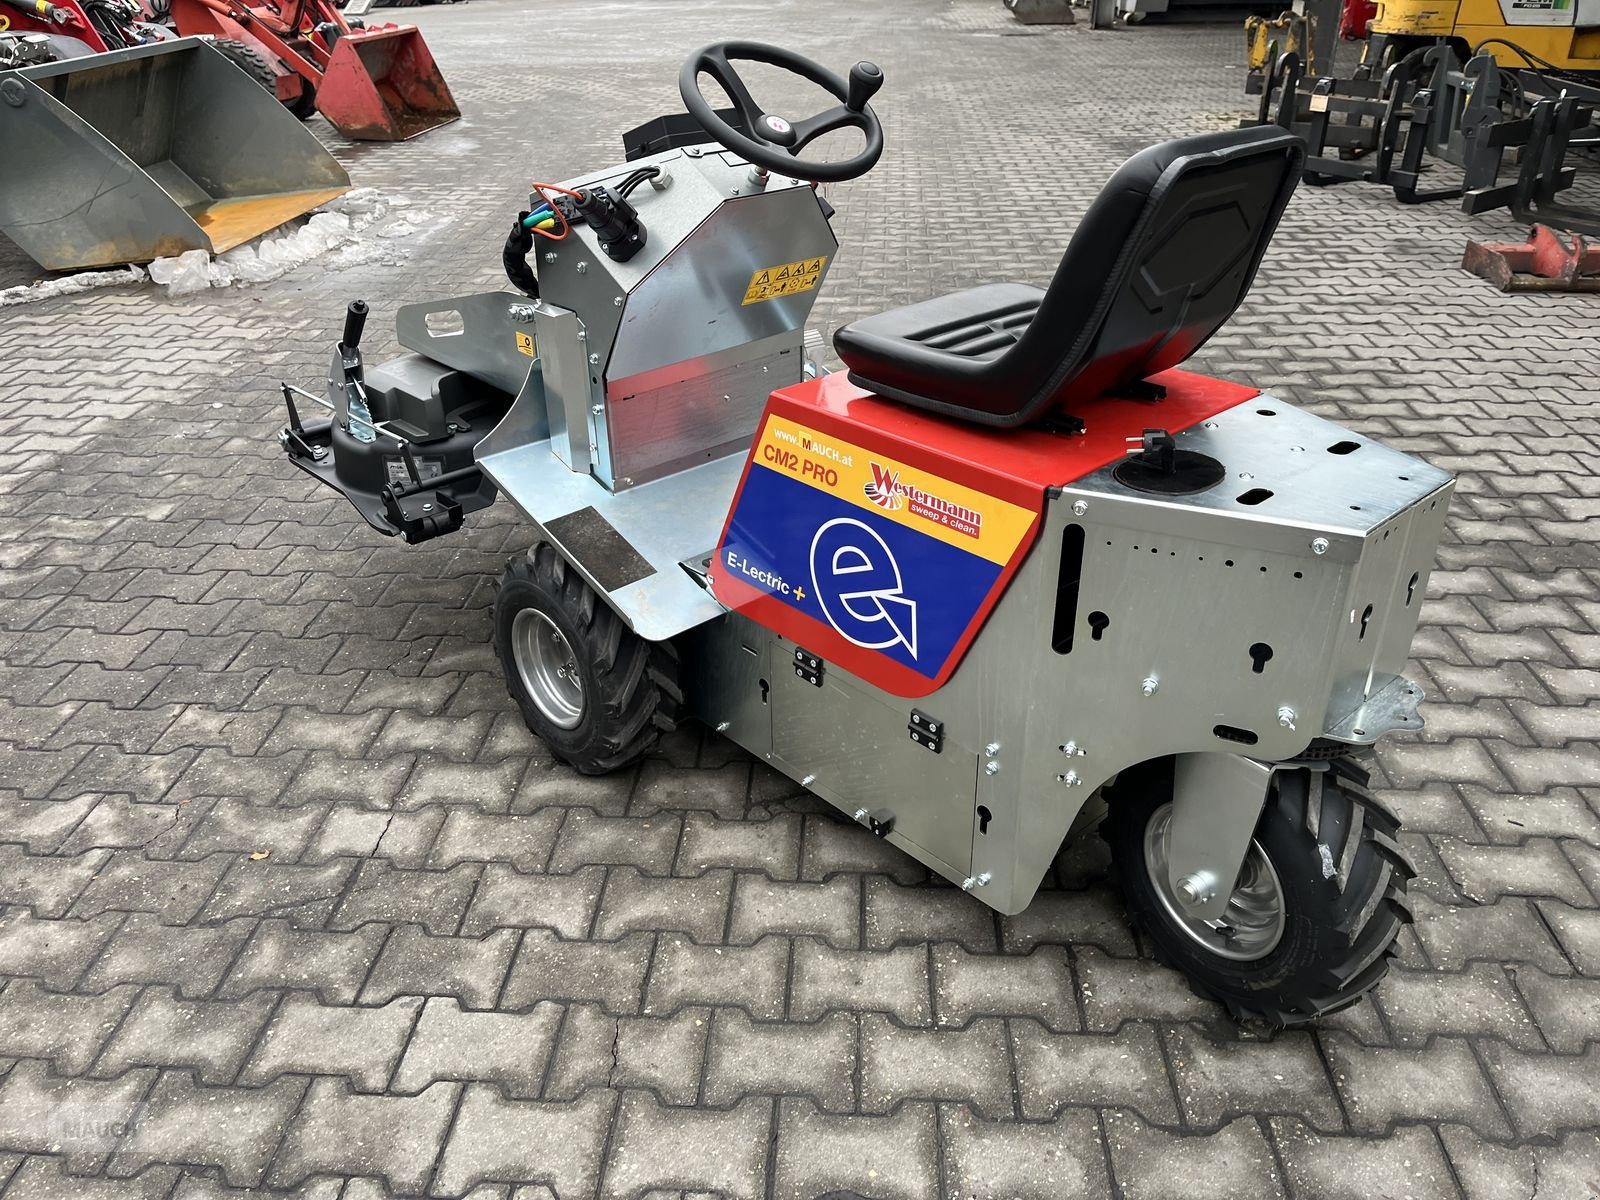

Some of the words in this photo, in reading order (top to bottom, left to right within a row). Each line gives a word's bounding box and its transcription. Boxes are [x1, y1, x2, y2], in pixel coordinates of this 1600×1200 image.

[763, 444, 798, 472] CM2
[802, 461, 839, 488] PRO
[870, 462, 982, 525] Westermann
[911, 502, 940, 521] sweep
[941, 513, 948, 524] &
[727, 551, 790, 595] E-Lectric
